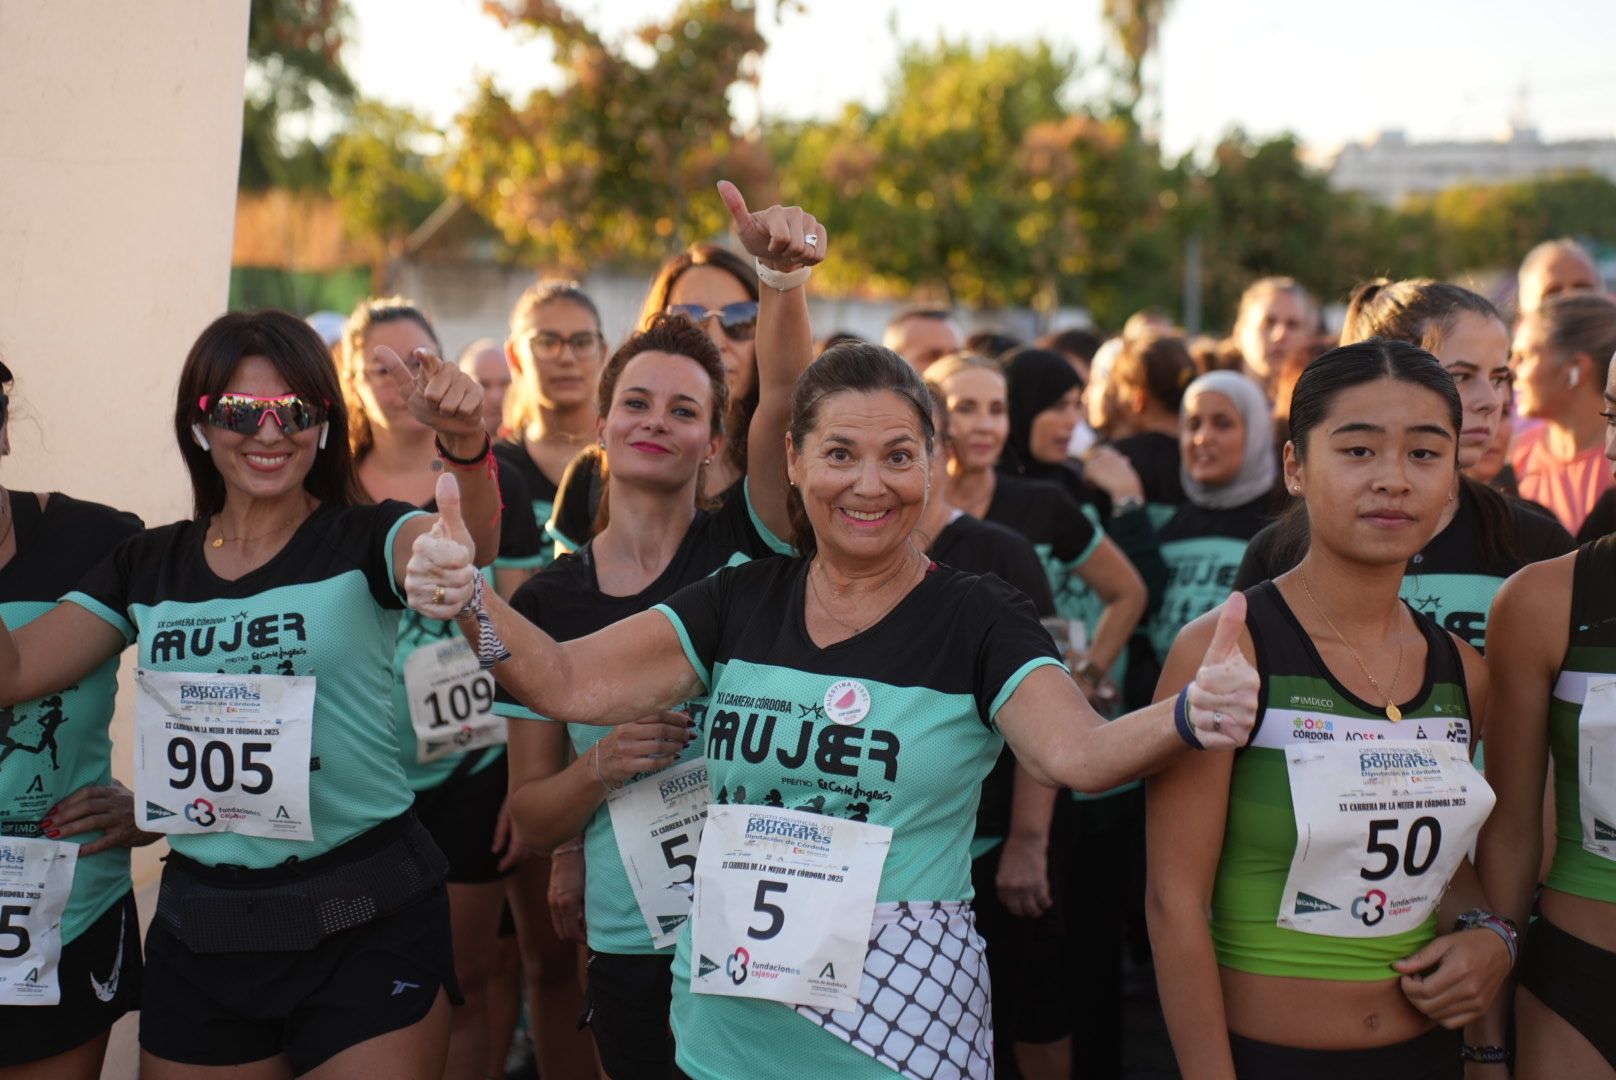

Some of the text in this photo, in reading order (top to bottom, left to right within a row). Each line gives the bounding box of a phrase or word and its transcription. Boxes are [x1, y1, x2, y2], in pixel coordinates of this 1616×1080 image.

[151, 612, 306, 665] MUJER
[180, 684, 248, 693] carreras
[181, 690, 261, 701] populares
[424, 677, 494, 729] 109
[754, 696, 792, 714] CÓRDOBA
[1300, 696, 1334, 708] IMDECO
[226, 727, 234, 735] DE
[263, 728, 280, 736] 2025
[1293, 729, 1335, 742] CÓRDOBA
[708, 709, 901, 783] MUJER
[1360, 752, 1422, 761] carreras
[167, 736, 274, 795] 905
[1360, 758, 1438, 771] populares
[781, 777, 813, 788] PREMIO
[1339, 798, 1467, 812] XX CARRERA DE LA MUJER DE CÓRDOBA 2025
[218, 807, 261, 818] fundaciones
[659, 821, 683, 834] CARRERA
[748, 817, 819, 835] carreras
[746, 824, 832, 845] populares
[745, 833, 783, 845] Diputación
[784, 838, 796, 846] de
[796, 840, 830, 852] Córdoba
[1360, 816, 1442, 881] 50
[728, 861, 750, 870] CARRERA
[750, 863, 758, 871] DE
[758, 864, 767, 872] LA
[768, 866, 787, 875] MUJER
[787, 867, 796, 876] DE
[797, 868, 826, 881] CÓRDOBA
[827, 873, 844, 883] 2025
[26, 891, 42, 900] 2025
[747, 879, 789, 940] 5
[751, 969, 780, 980] cajasur
[752, 961, 801, 975] fundaciones
